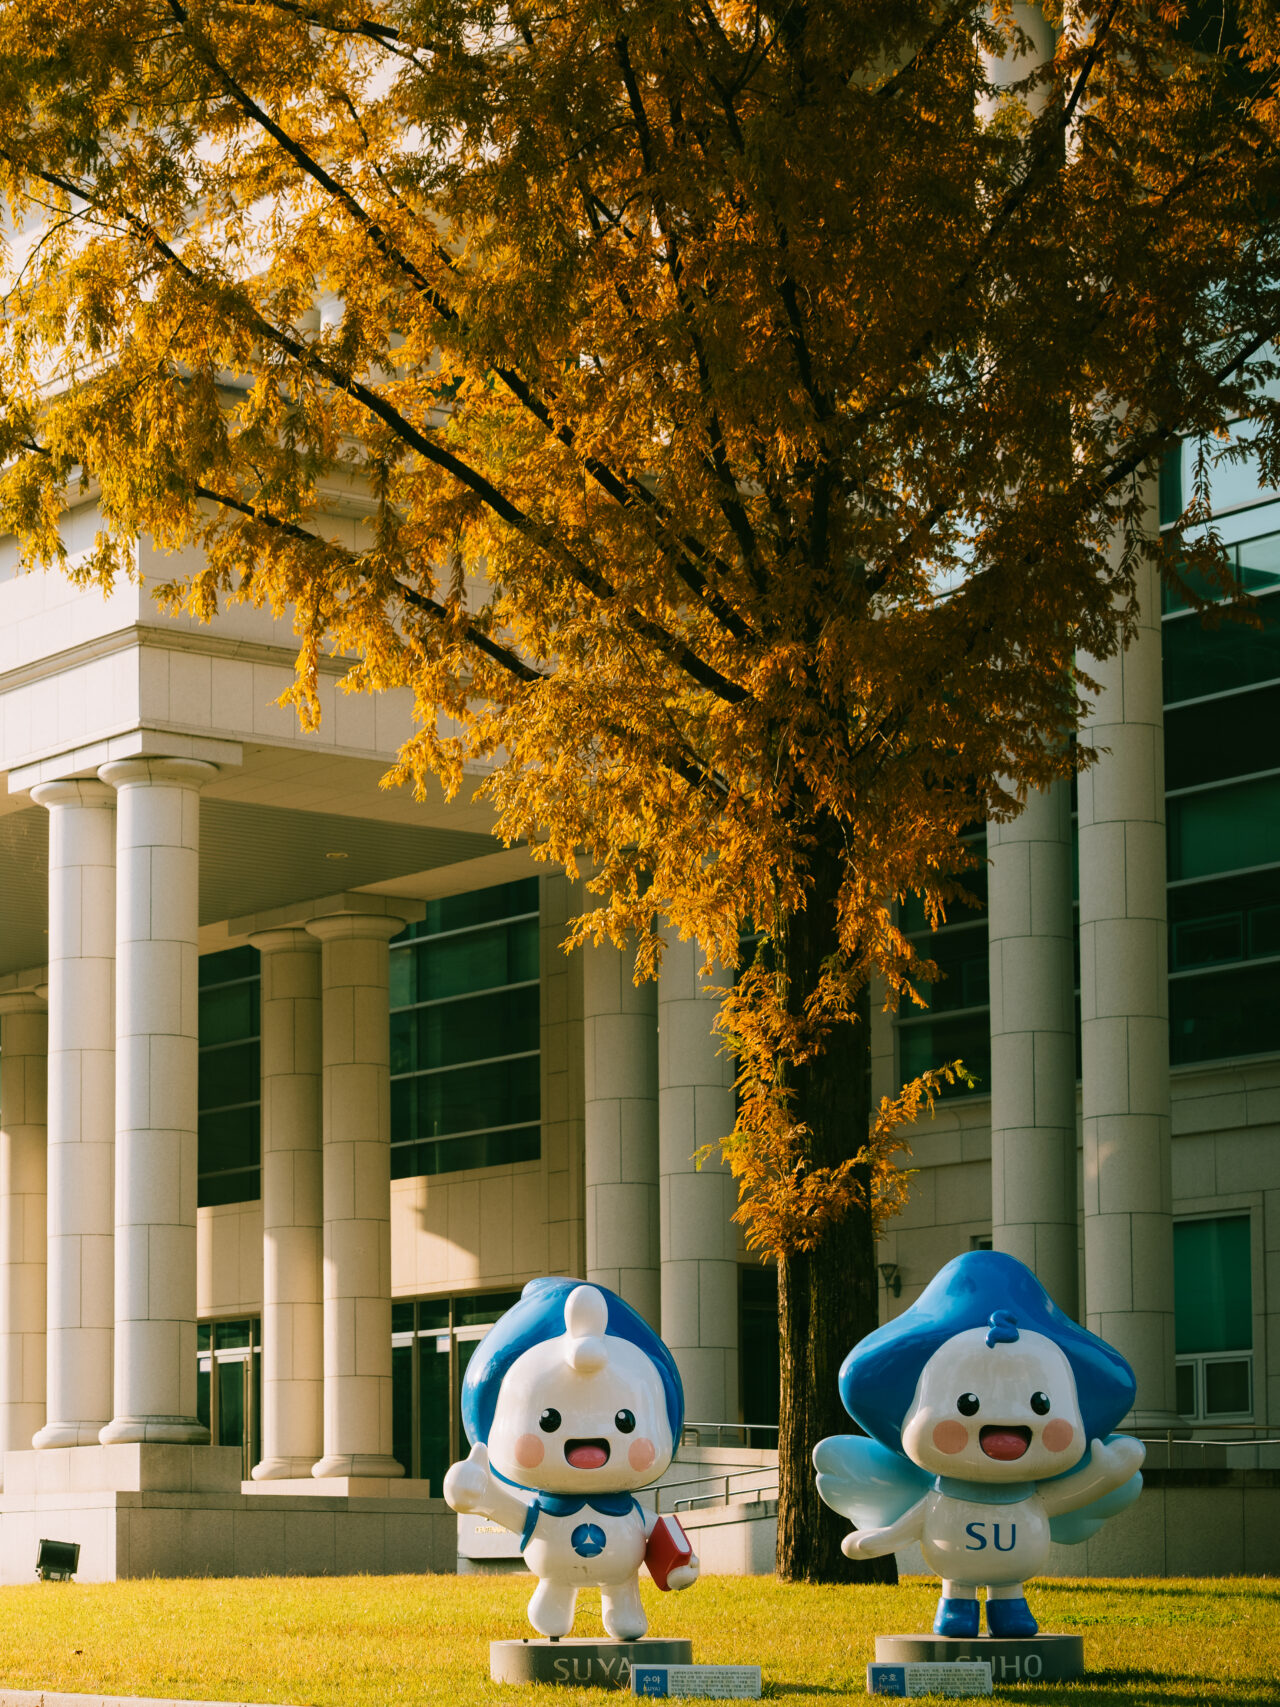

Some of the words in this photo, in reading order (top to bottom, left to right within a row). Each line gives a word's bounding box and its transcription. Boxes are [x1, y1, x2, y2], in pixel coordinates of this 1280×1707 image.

[965, 1522, 1016, 1551] SU
[553, 1656, 632, 1681] SUYA
[955, 1654, 1043, 1678] UHO
